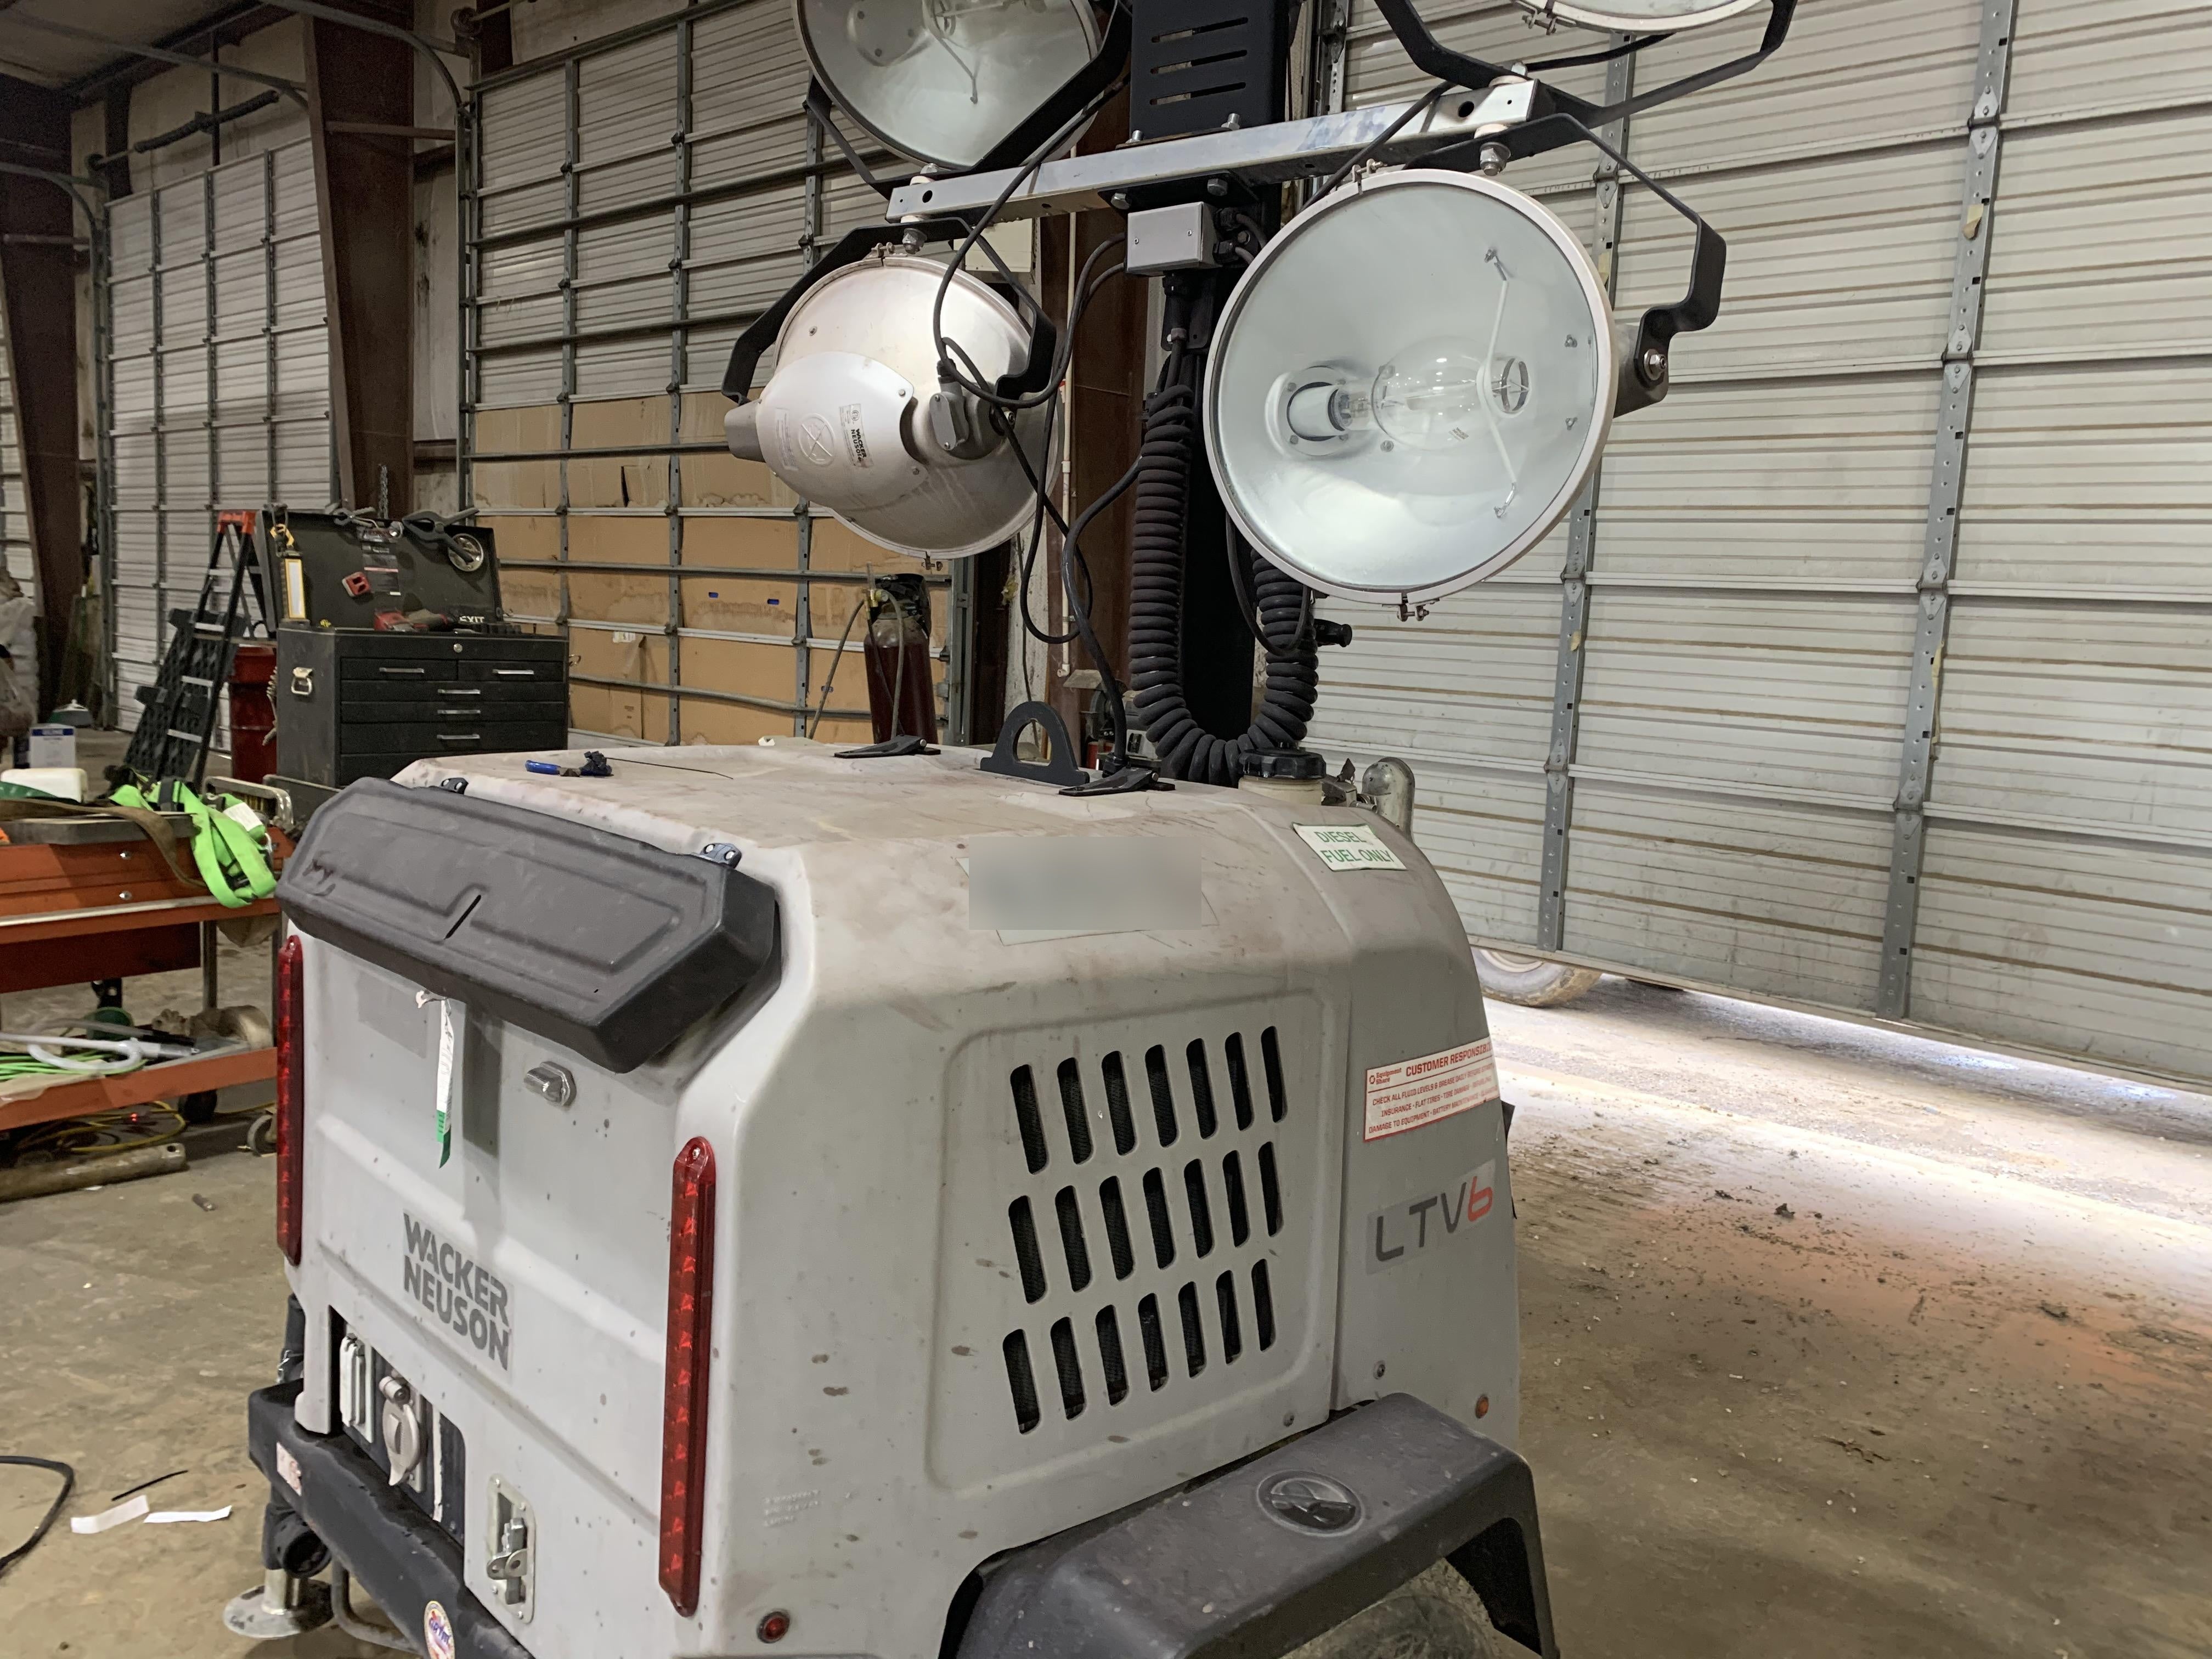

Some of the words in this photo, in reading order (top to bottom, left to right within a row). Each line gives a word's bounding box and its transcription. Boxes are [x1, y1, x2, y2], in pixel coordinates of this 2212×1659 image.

[856, 428, 867, 458] WACKER
[1314, 831, 1367, 843] DIESEL
[1320, 850, 1361, 863] FUEL
[1361, 849, 1395, 862] ONLY
[1376, 1068, 1402, 1079] Equipment
[1406, 1056, 1448, 1077] CUSTOMER
[1373, 1095, 1391, 1105] CHECK
[1402, 1088, 1417, 1099] FLUID
[1418, 1084, 1434, 1095] LEVELS
[1381, 1104, 1412, 1117] INSURANCE
[1415, 1099, 1426, 1108] FLAT
[1426, 1095, 1440, 1105] TIRES
[1369, 1121, 1392, 1134] DAMAGE
[1401, 1110, 1430, 1126] EQUIPMENT
[1375, 1176, 1493, 1262] LTV6
[403, 1212, 510, 1327] WACKER
[403, 1255, 510, 1372] NEUSON
